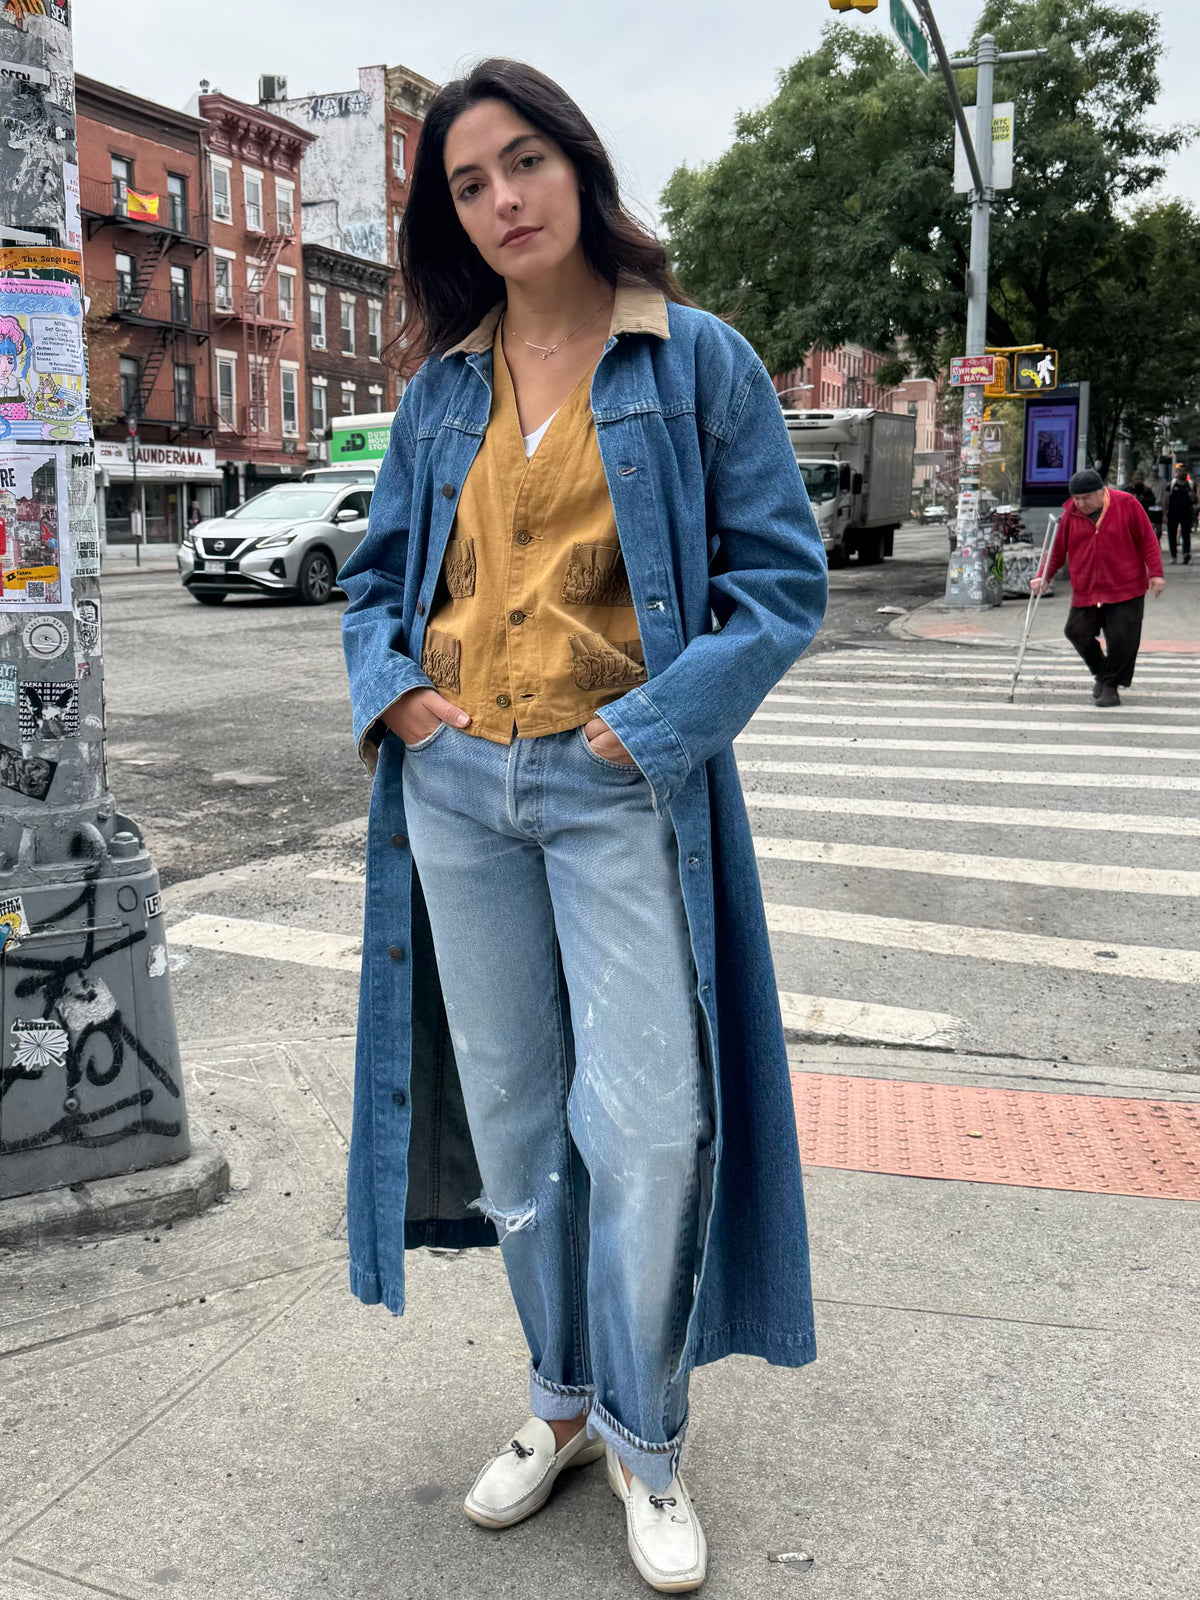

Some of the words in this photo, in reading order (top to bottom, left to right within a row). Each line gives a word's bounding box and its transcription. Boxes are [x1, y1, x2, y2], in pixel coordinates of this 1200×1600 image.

[51, 3, 66, 24] SEX
[22, 255, 37, 263] The
[41, 256, 61, 264] Songs
